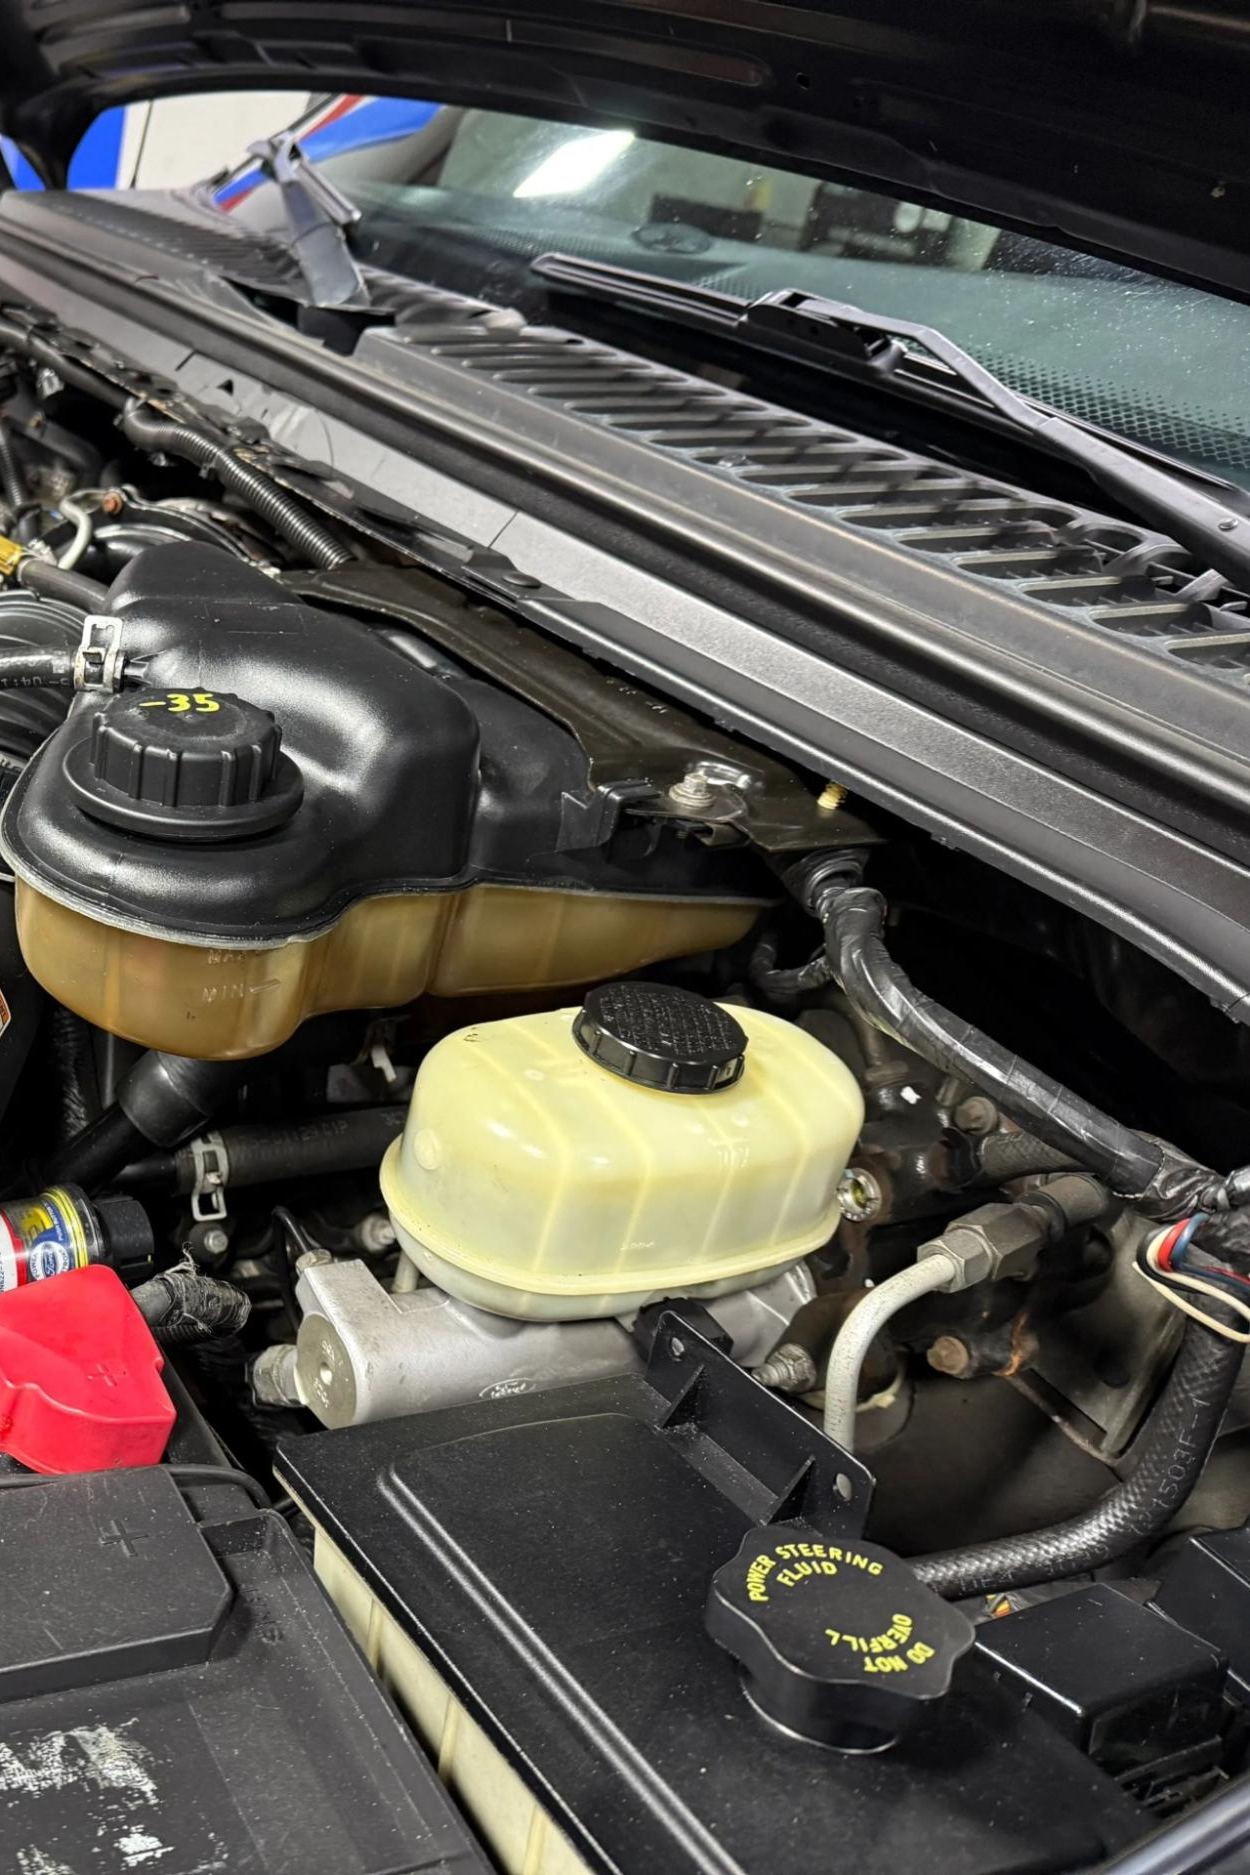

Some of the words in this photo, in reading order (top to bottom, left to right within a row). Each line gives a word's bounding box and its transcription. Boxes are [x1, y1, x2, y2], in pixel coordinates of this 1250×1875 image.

[138, 692, 220, 713] -35
[746, 1554, 777, 1602] POWER
[775, 1543, 884, 1576] STEERING
[776, 1560, 838, 1588] FLUID
[825, 1613, 913, 1654] OVERFILL
[863, 1655, 909, 1673] NOT
[906, 1641, 936, 1665] DO
